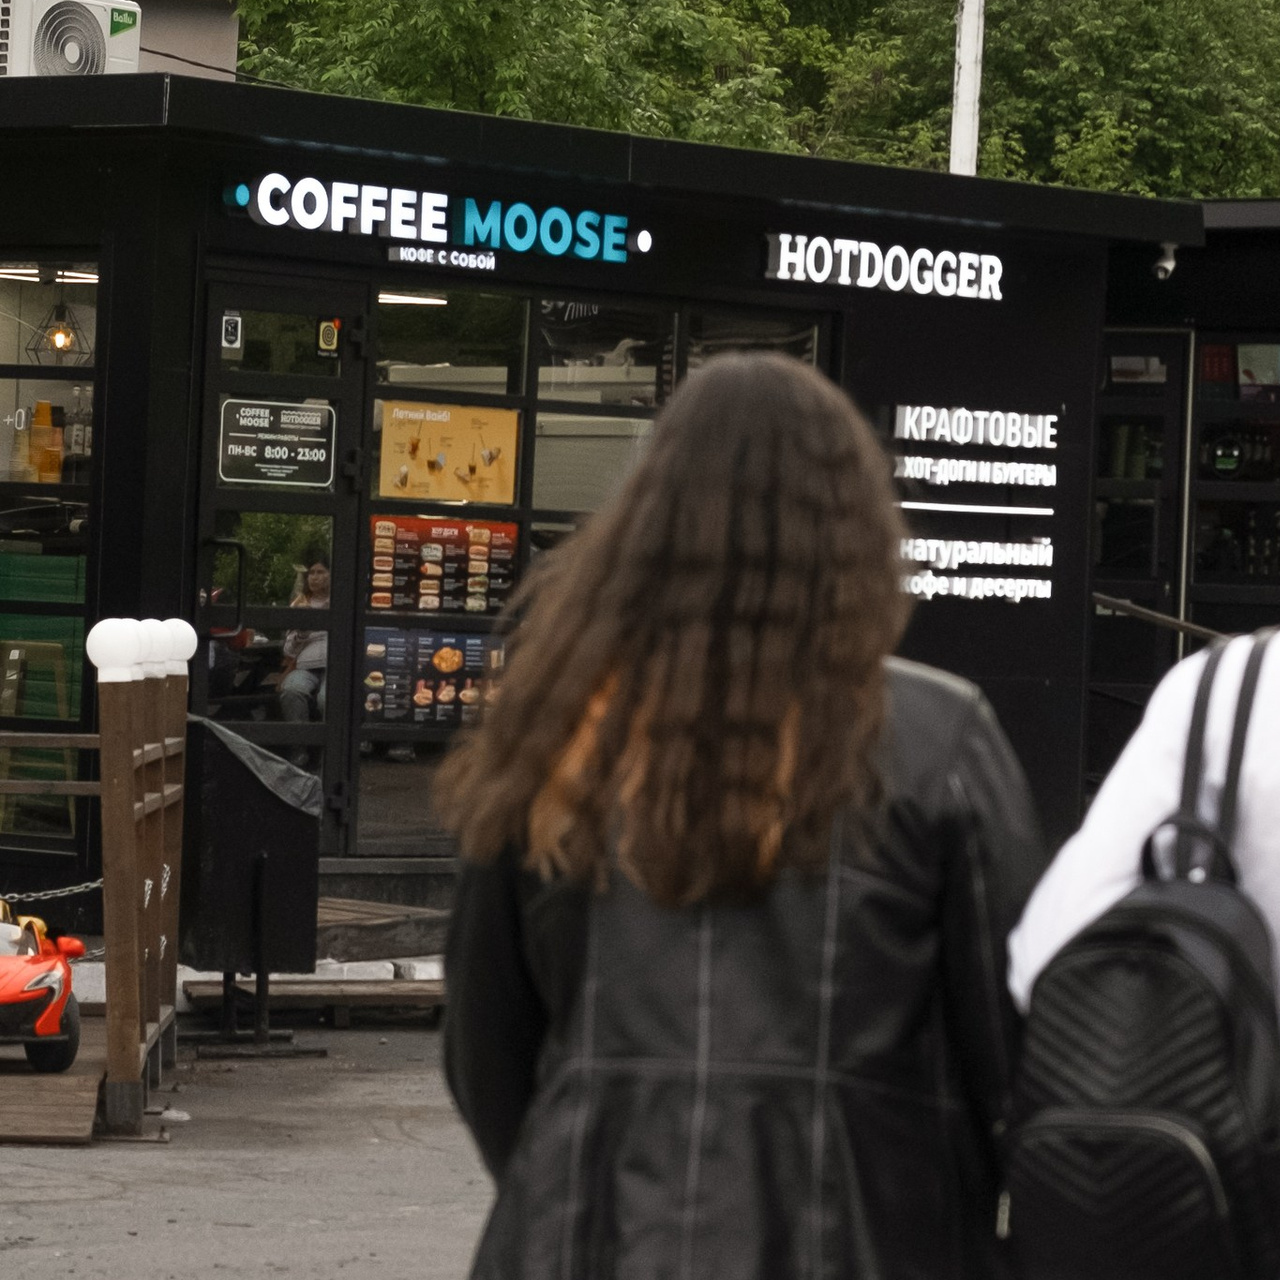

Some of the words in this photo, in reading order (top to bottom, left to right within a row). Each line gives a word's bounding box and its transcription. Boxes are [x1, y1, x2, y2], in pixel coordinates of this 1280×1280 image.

[257, 173, 448, 243] COFFEE
[464, 197, 628, 263] MOOSE
[400, 246, 434, 263] КОФЕ
[450, 250, 496, 271] СОБОЙ
[777, 233, 1003, 301] HOTDOGGER
[240, 407, 270, 419] COFFEE
[903, 405, 1059, 449] КРАФТОВЫЕ
[228, 444, 257, 457] ПН-ВС
[264, 446, 288, 460] 8:00
[297, 448, 326, 462] 23:00
[904, 456, 977, 486] ХОТ-ДОГИ
[992, 462, 1058, 487] БУРГЕРЫ
[901, 537, 1054, 570] натуральный
[969, 577, 1052, 604] десерты
